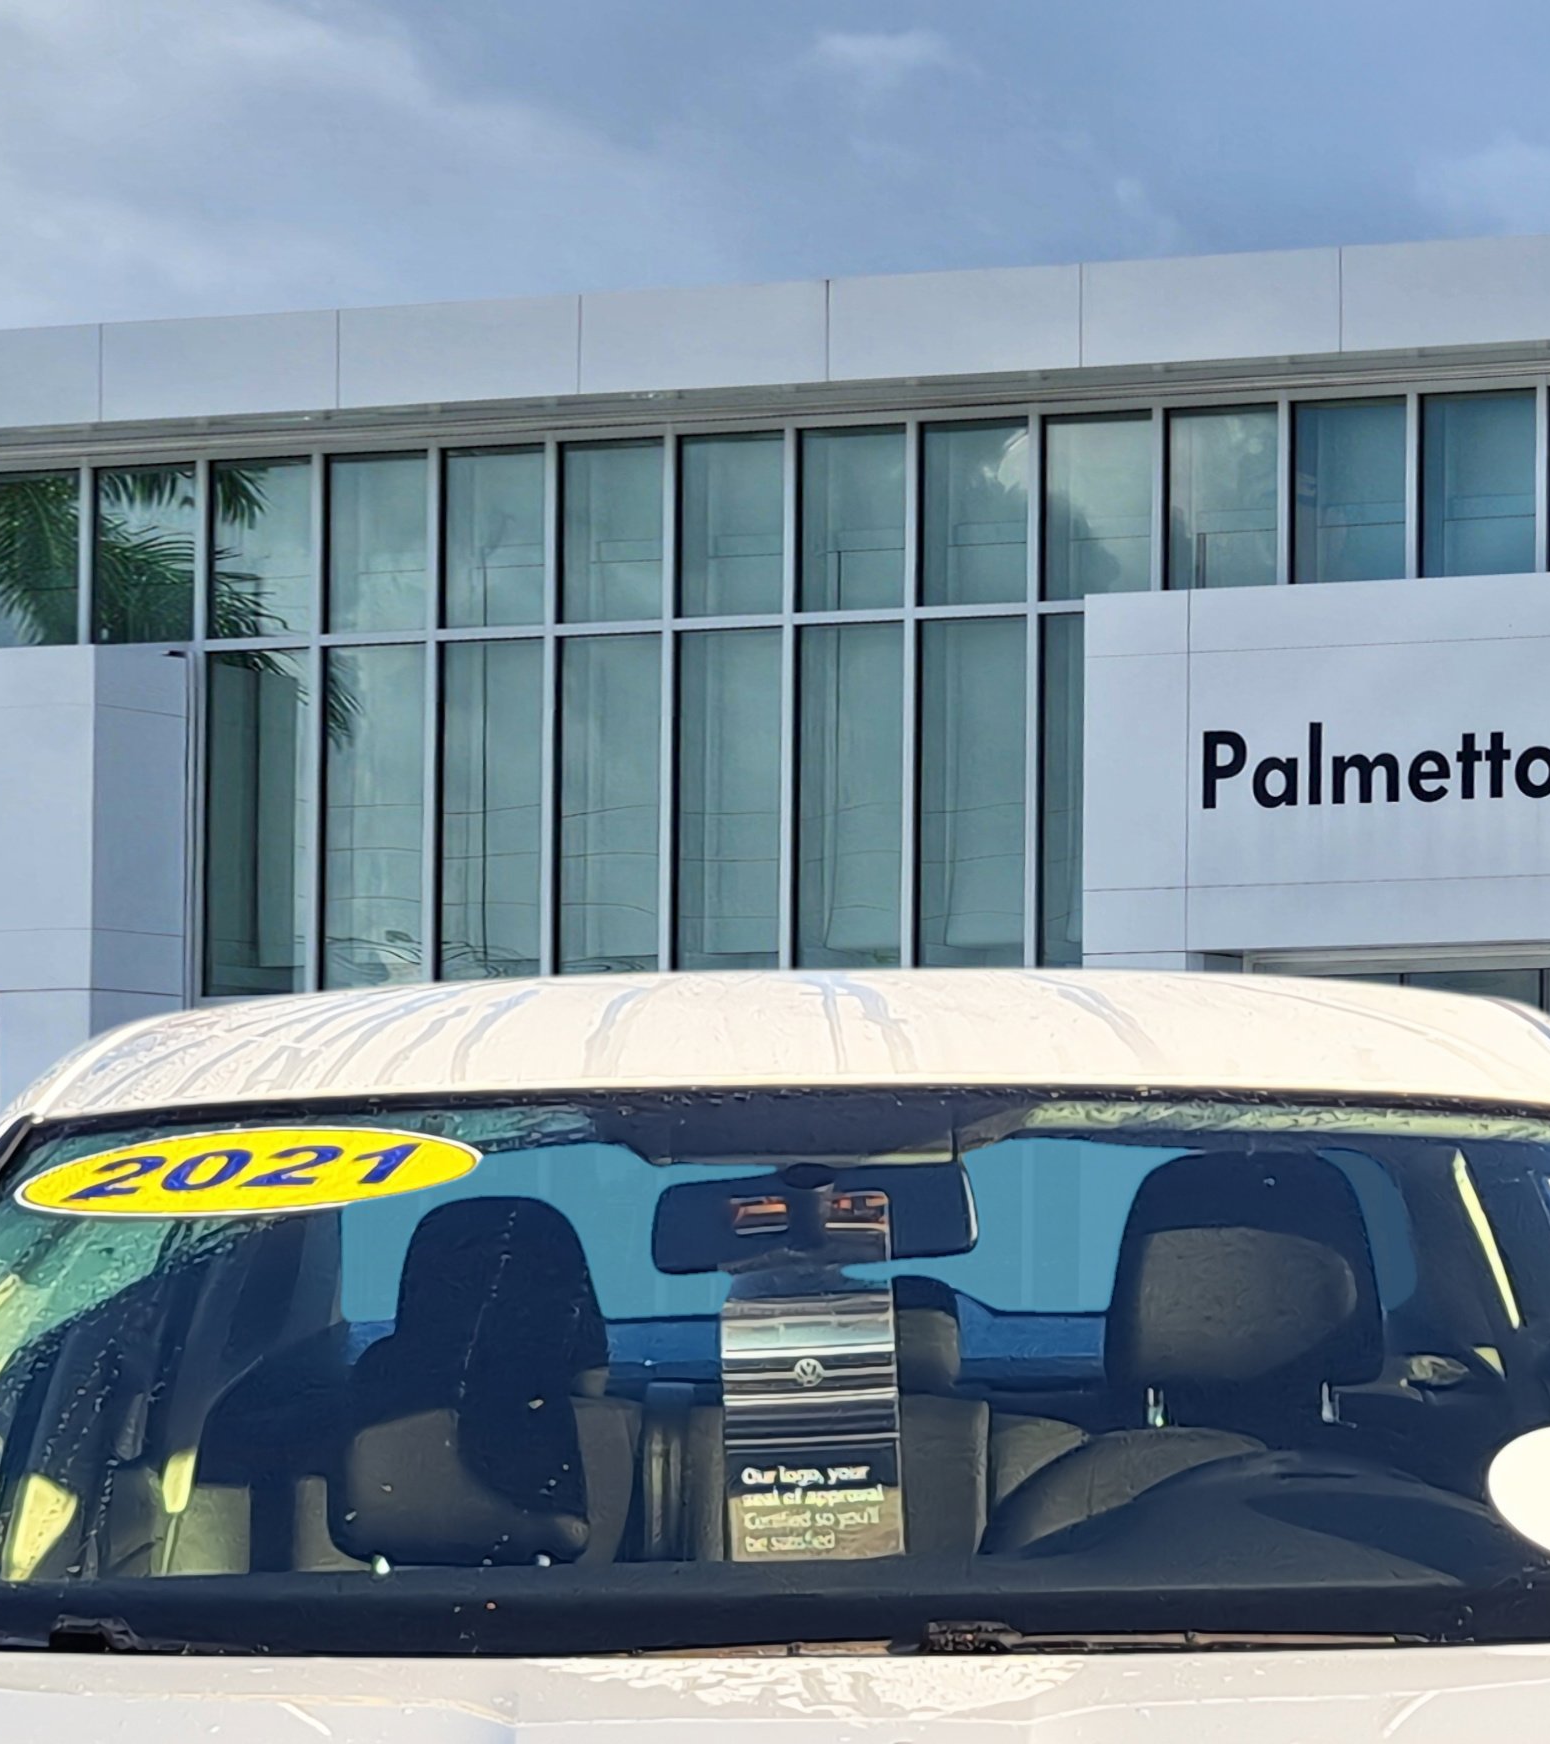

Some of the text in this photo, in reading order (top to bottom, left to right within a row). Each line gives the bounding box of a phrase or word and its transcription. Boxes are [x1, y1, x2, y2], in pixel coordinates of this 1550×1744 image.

[62, 1143, 422, 1202] 2021
[741, 1467, 777, 1485] Our
[827, 1465, 870, 1485] your
[815, 1512, 835, 1526] so
